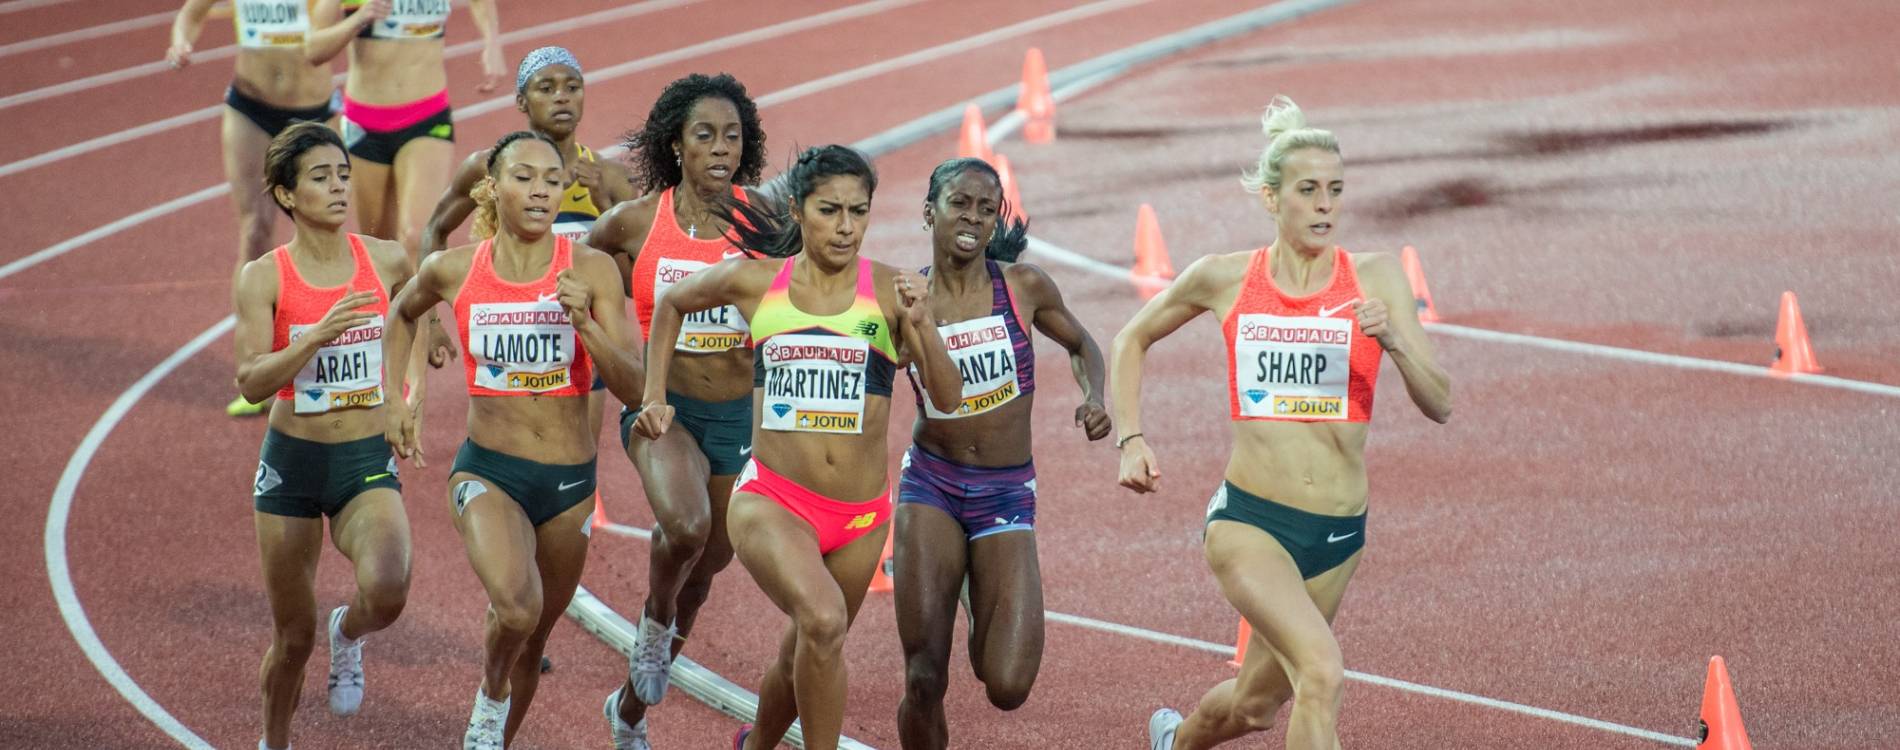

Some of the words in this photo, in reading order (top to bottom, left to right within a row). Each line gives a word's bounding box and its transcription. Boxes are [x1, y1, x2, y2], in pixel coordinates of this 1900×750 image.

[488, 311, 571, 325] BAUHAUS
[700, 337, 742, 348] JOTUN
[947, 326, 1007, 350] UHAUS
[1257, 326, 1347, 344] BAUHAUS
[484, 334, 562, 363] LAMOTE
[780, 346, 866, 364] BAUHAUS
[315, 351, 368, 383] ARAFI
[959, 348, 1014, 385] ANZA
[1257, 351, 1327, 385] SHARP
[523, 372, 564, 388] JOTUN
[768, 367, 861, 400] MARTINEZ
[346, 389, 380, 405] JOTUN
[974, 385, 1013, 410] JOTUN
[1292, 400, 1339, 413] JOTUN
[812, 415, 856, 428] JOTUN
